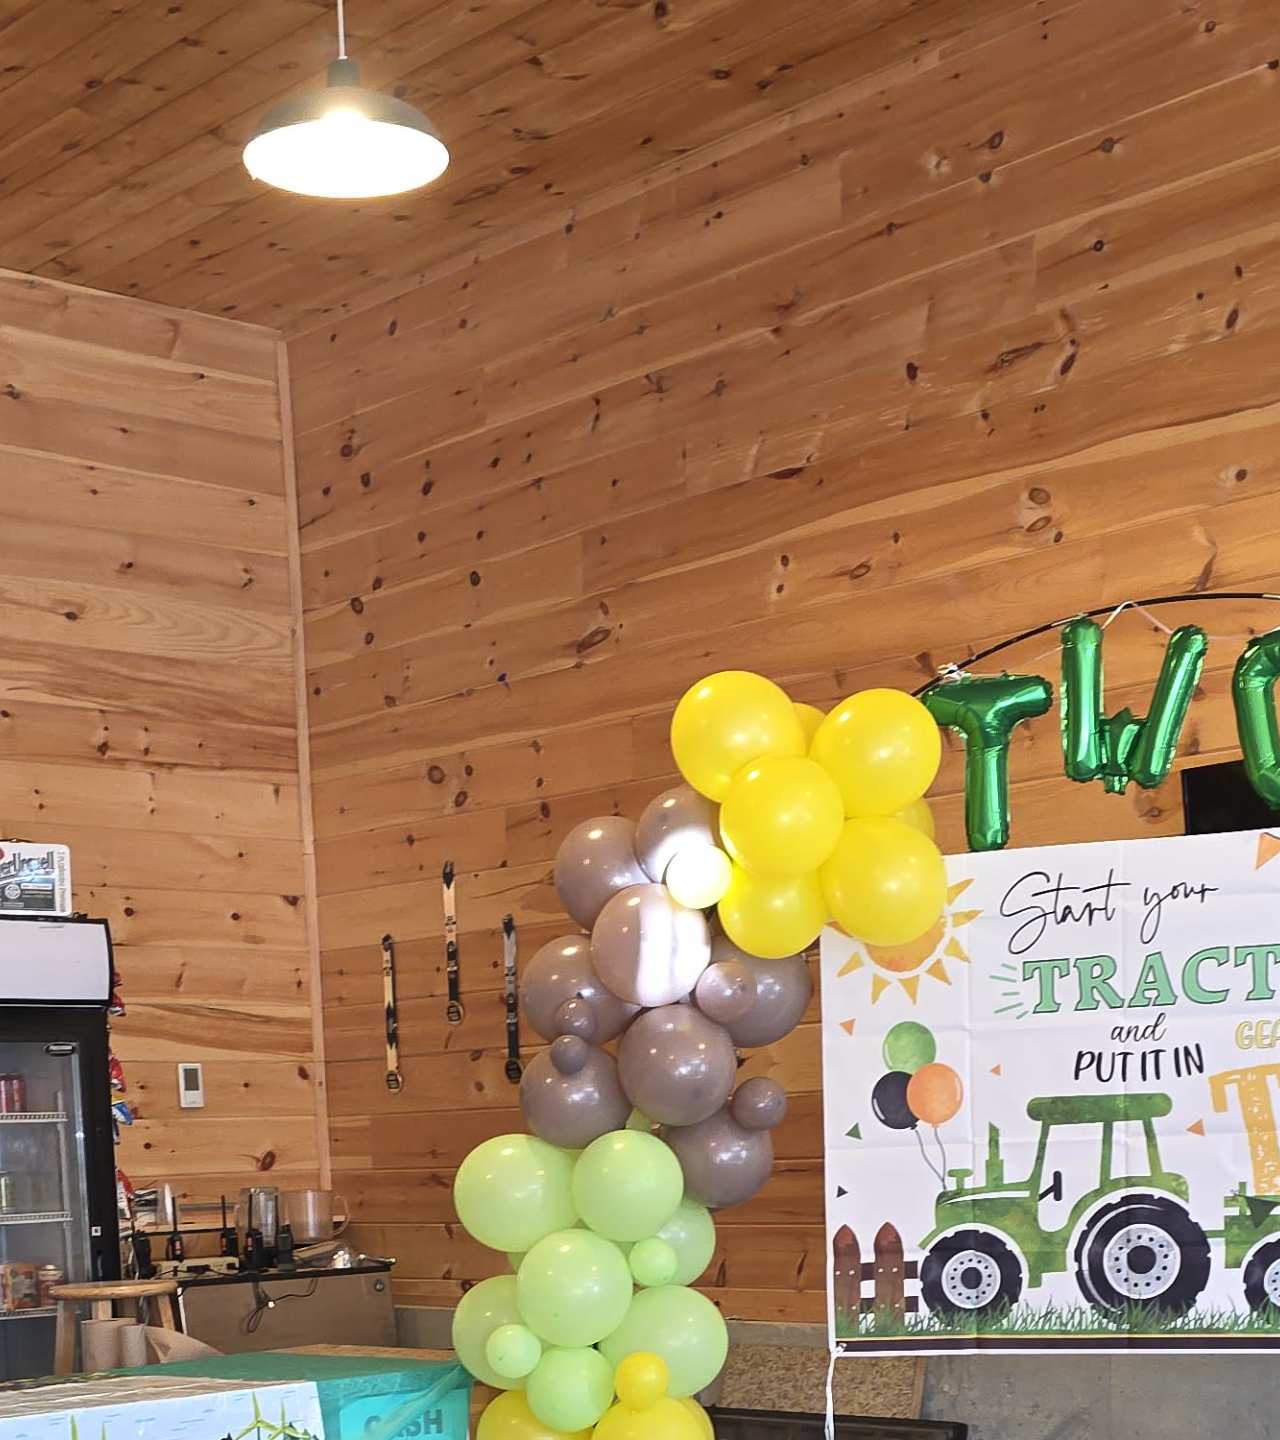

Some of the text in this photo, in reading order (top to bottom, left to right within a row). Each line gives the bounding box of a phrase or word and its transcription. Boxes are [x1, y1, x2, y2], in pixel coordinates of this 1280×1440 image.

[999, 868, 1220, 955] Start your
[1109, 1012, 1167, 1043] and
[1072, 1042, 1206, 1084] PUT IT IN
[364, 1408, 444, 1439] CSH
